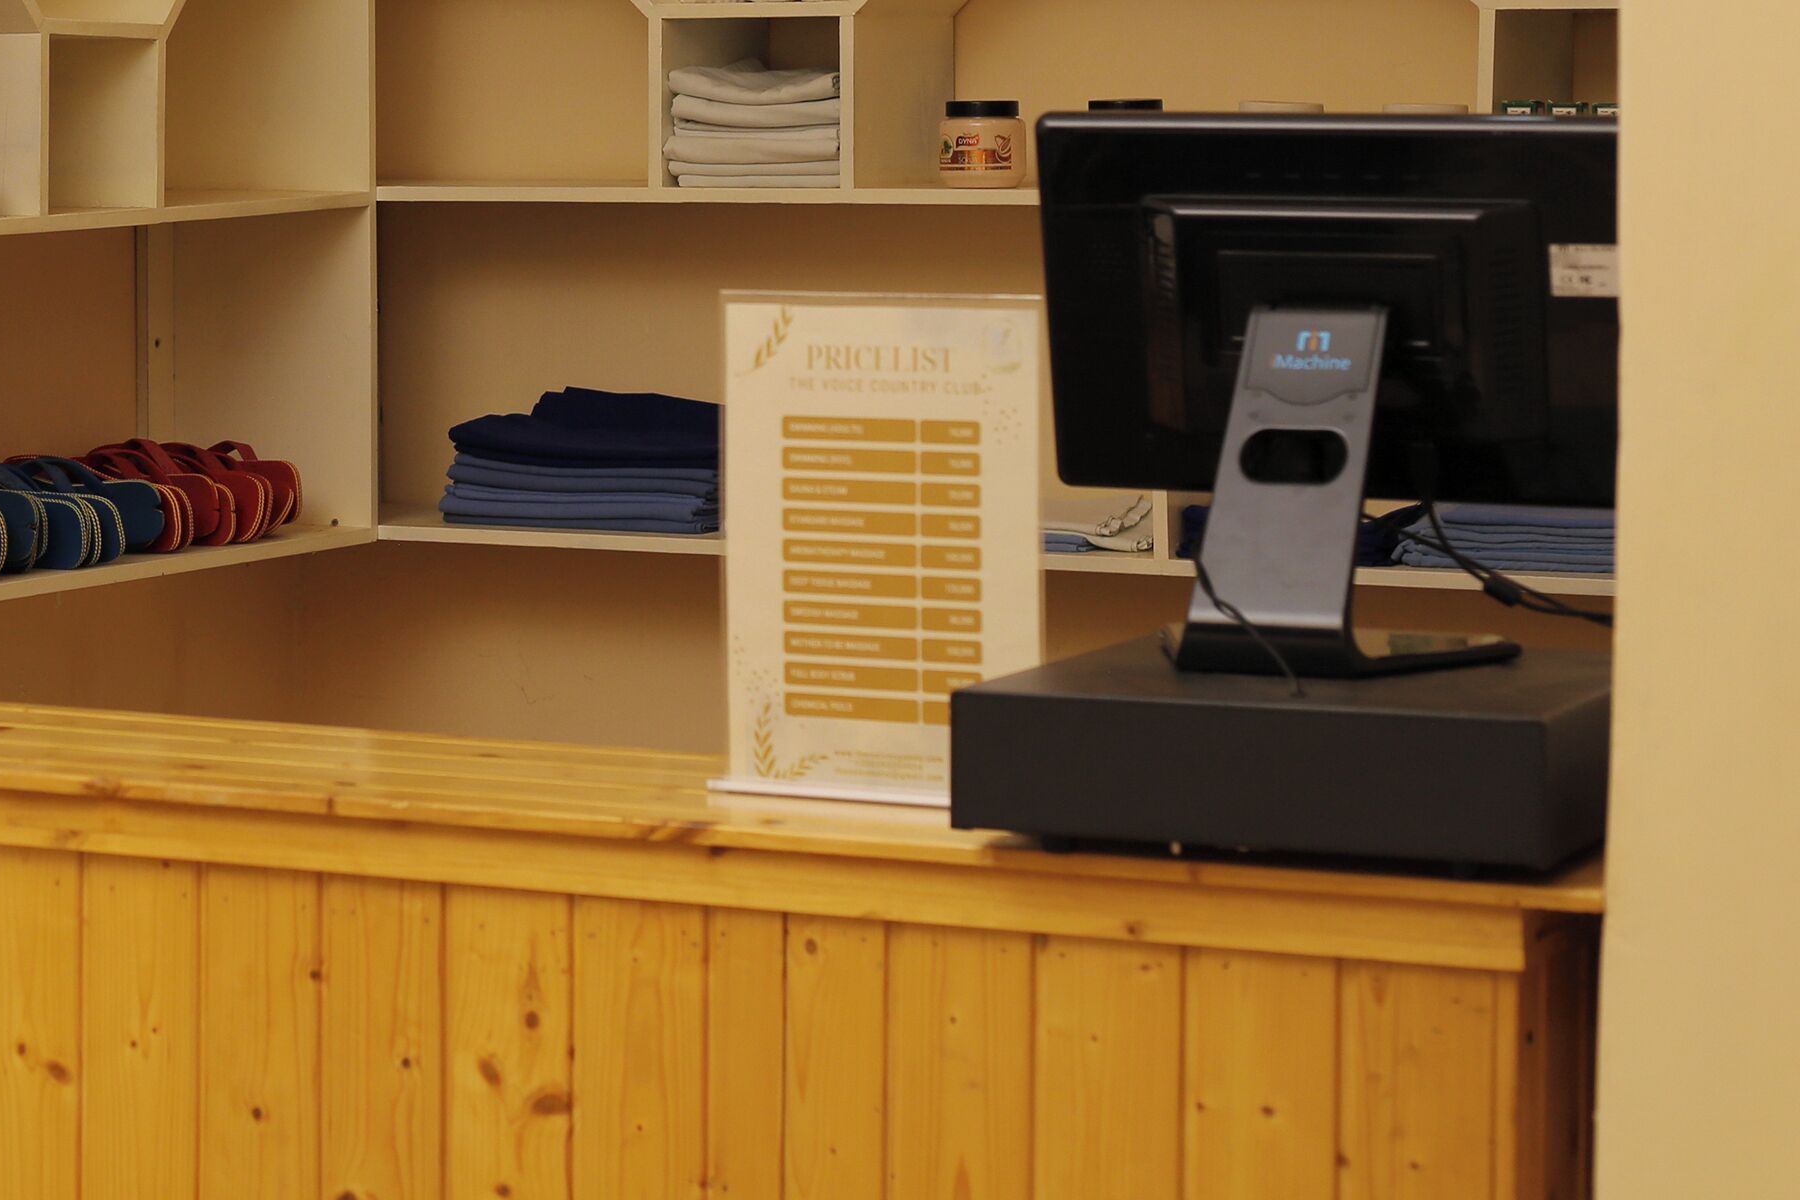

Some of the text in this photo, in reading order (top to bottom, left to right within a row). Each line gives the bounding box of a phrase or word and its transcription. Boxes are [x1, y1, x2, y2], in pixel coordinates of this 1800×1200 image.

[806, 344, 952, 373] PRICELIST
[1271, 354, 1352, 370] iMachine
[790, 377, 981, 396] THE VOICE COUNTRY CLUB
